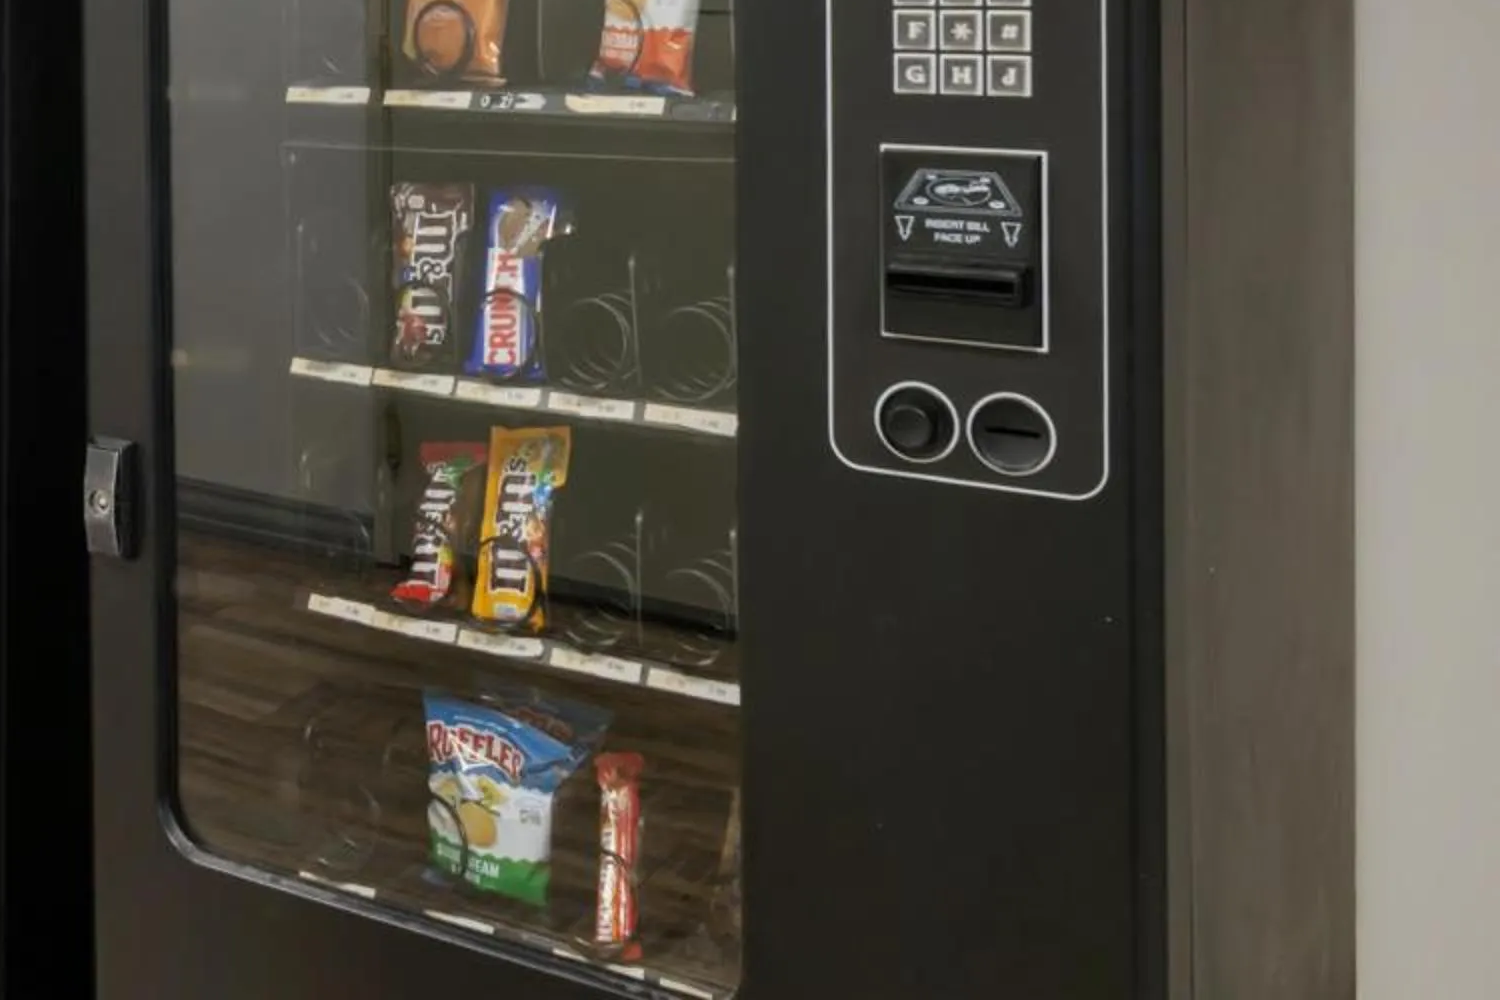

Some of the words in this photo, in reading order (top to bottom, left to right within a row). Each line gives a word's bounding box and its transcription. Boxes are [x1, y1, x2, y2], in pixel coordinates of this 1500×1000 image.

[908, 21, 927, 40] F
[905, 65, 927, 85] G
[951, 66, 972, 86] H
[1001, 67, 1018, 87] J
[925, 218, 964, 230] INSERT
[965, 221, 990, 233] BILL
[933, 232, 963, 244] FACE
[965, 234, 981, 244] UP
